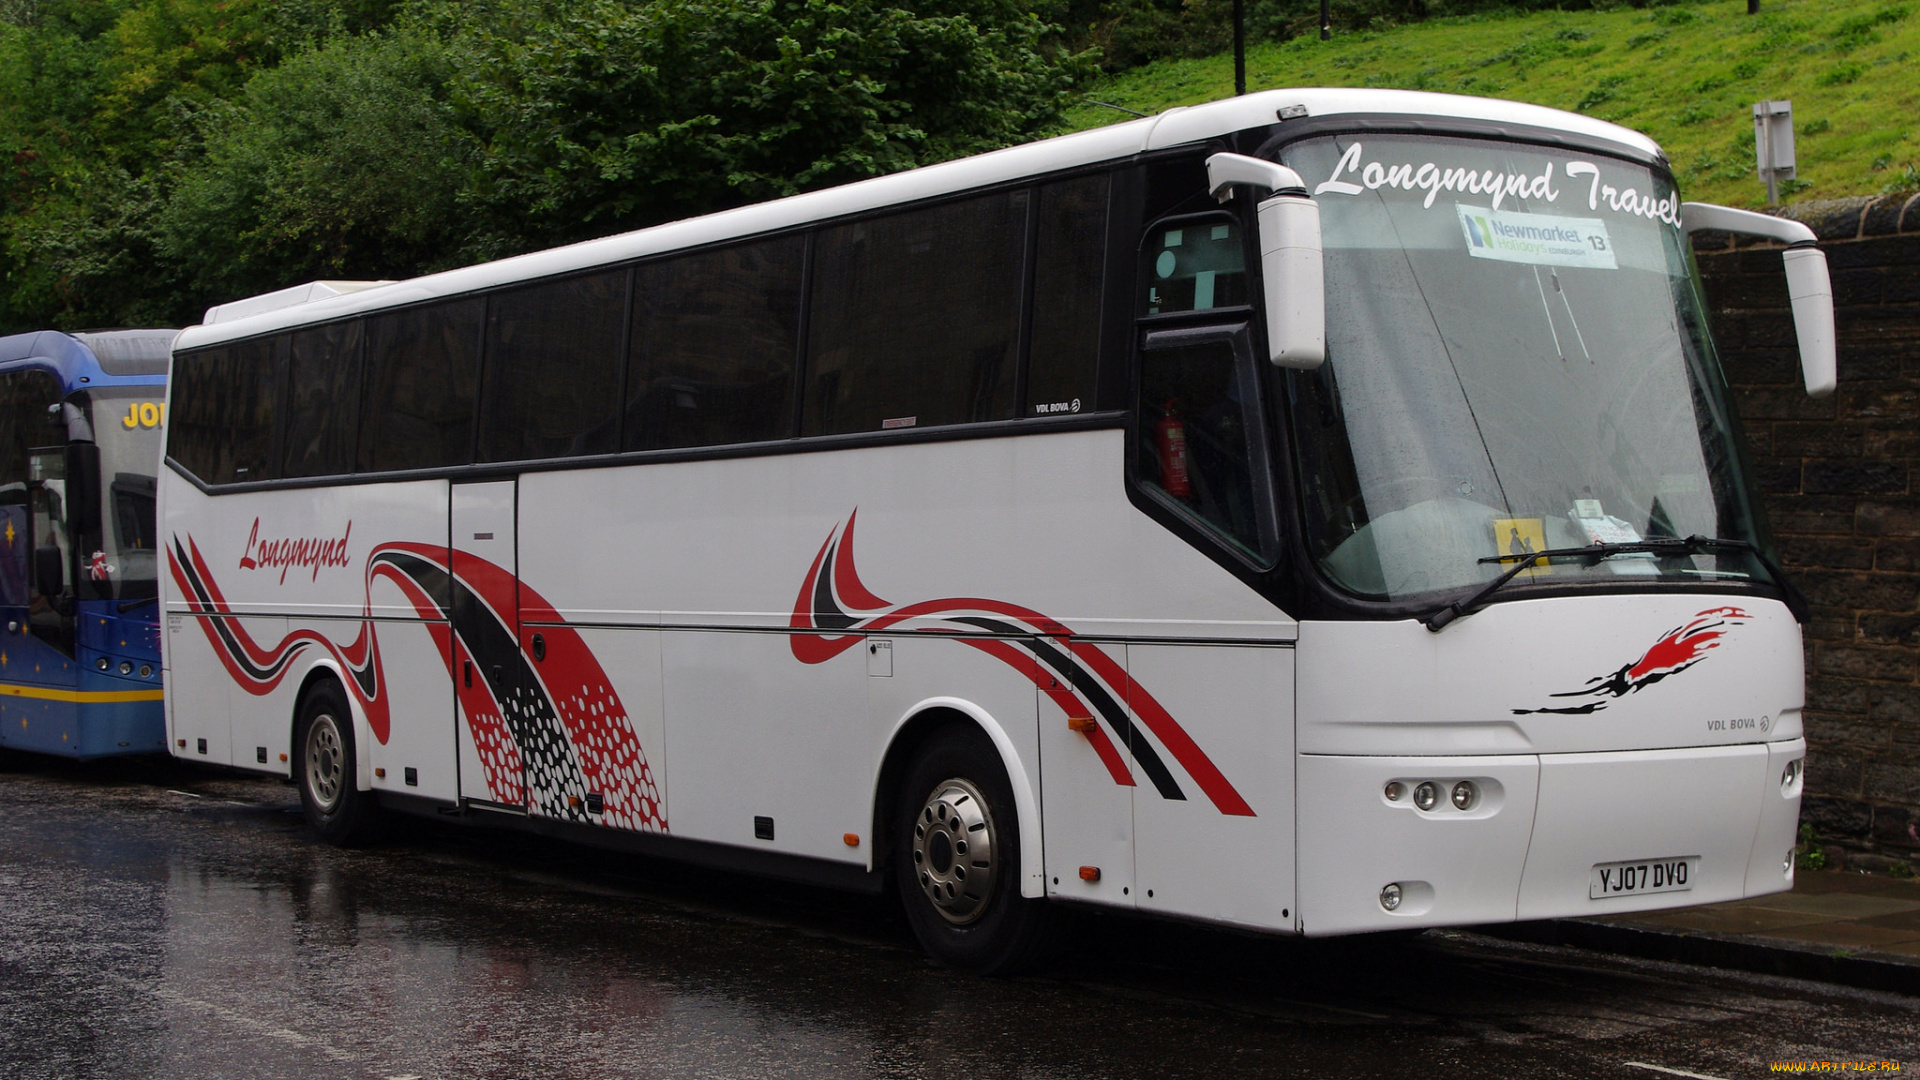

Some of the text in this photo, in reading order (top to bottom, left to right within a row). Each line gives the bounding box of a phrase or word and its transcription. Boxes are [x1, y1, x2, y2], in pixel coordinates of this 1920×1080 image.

[1315, 142, 1683, 230] Longmynd Travel
[1491, 219, 1582, 244] Newmarket
[1498, 238, 1586, 256] Holidays EDINBURGH
[1587, 235, 1606, 251] 13
[1036, 402, 1069, 413] VDL BOVA
[239, 516, 351, 586] Longmynd
[1707, 718, 1755, 731] VDL BOVA
[1600, 861, 1688, 893] YJ07 DVO
